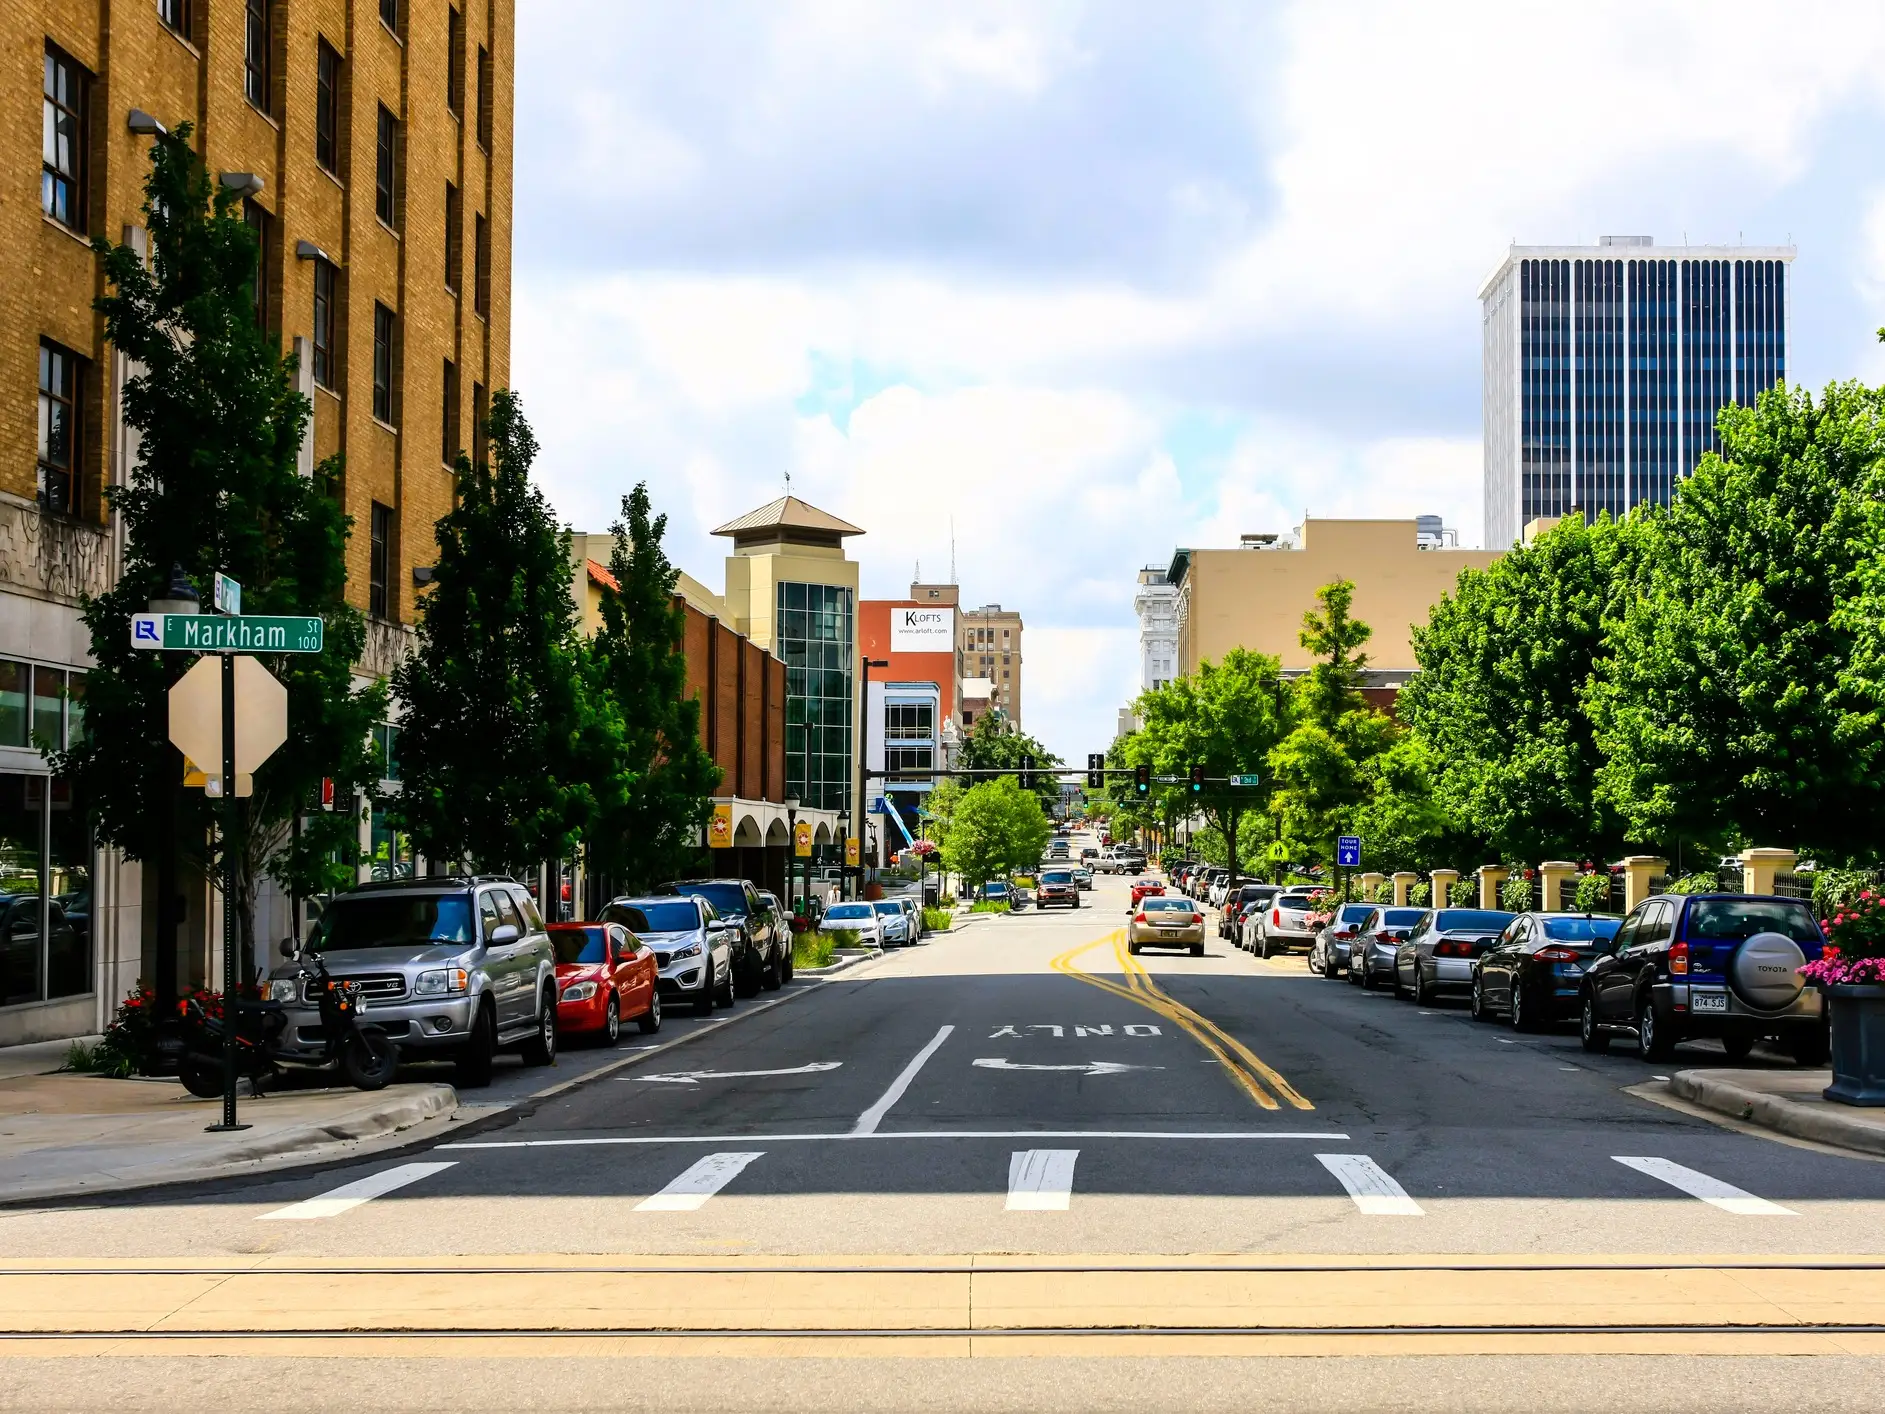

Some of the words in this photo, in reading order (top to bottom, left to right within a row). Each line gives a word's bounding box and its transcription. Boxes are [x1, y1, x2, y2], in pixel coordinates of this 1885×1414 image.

[167, 618, 173, 631] E
[184, 619, 286, 647] Markham
[307, 620, 318, 633] St
[298, 636, 318, 649] 100
[1757, 965, 1788, 973] TOYOTA
[1694, 998, 1708, 1007] 874
[1711, 999, 1725, 1008] SJS
[987, 1024, 1163, 1038] ONLY
